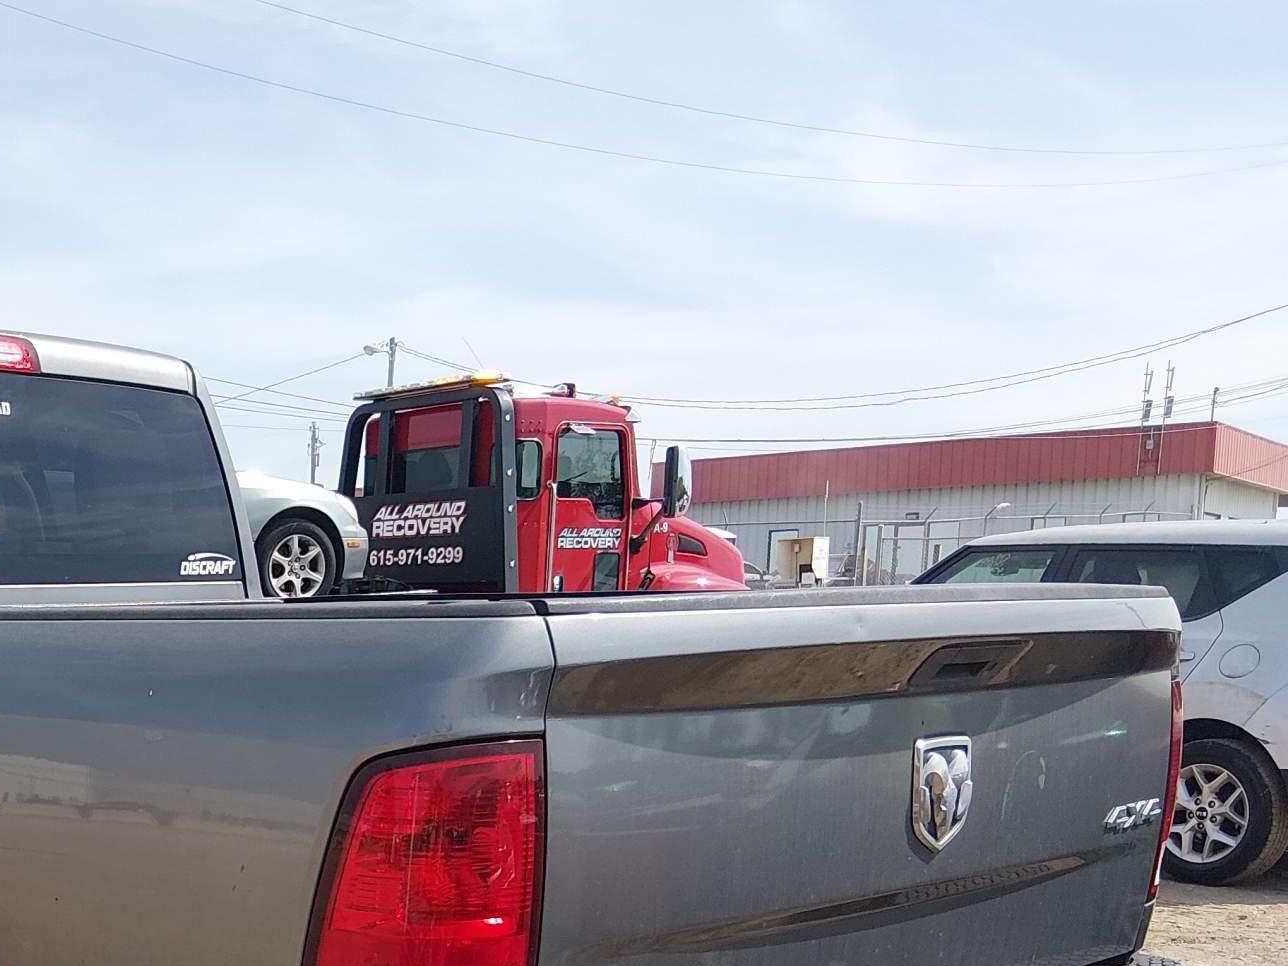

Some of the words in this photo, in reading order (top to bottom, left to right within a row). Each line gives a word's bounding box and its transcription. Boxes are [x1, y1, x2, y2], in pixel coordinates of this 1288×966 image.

[373, 504, 401, 521] ALL
[401, 501, 466, 519] AROUND
[372, 515, 467, 537] RECOVERY
[559, 528, 580, 537] ALL
[579, 528, 622, 537] AROUND
[653, 522, 669, 533] A-9
[557, 537, 621, 549] RECOVERY
[369, 546, 464, 567] 615-971-9299
[180, 560, 236, 576] DISCRAFT
